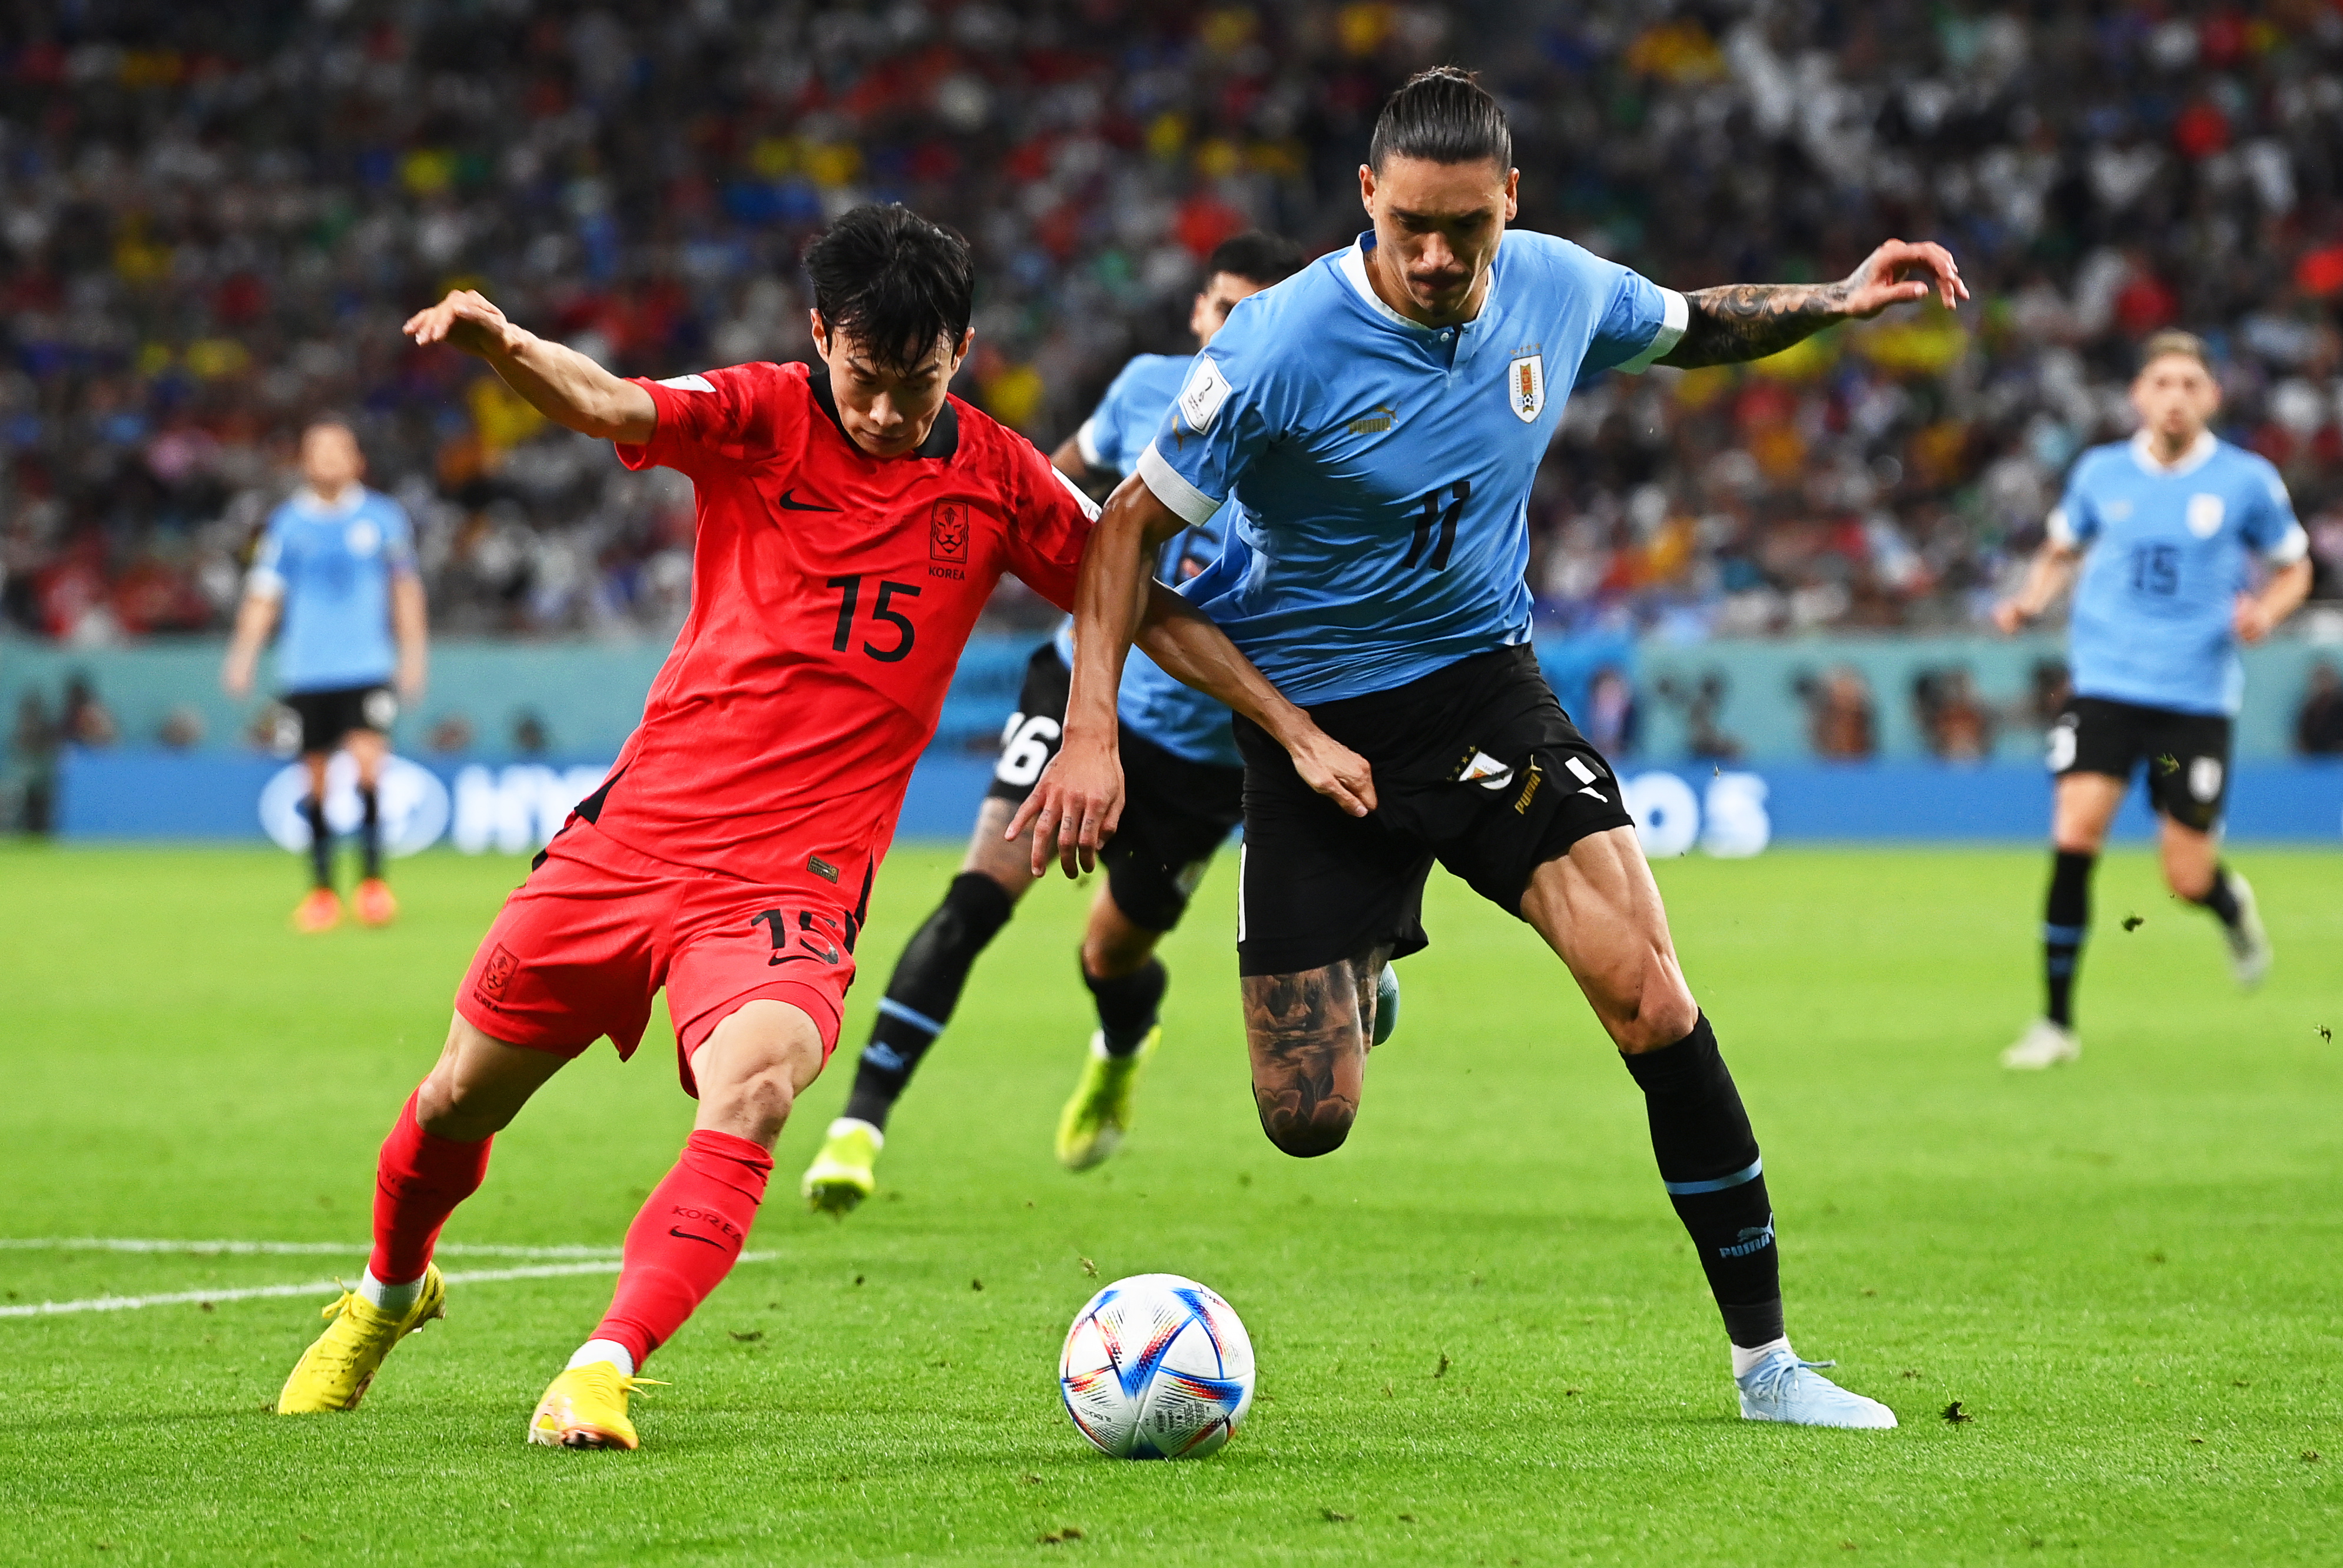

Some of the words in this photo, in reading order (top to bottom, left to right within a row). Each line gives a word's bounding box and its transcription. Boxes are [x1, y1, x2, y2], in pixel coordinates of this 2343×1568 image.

[1401, 481, 1470, 571] 11
[929, 565, 965, 581] KOREA
[2130, 543, 2179, 595] 15
[826, 575, 922, 662] 15
[1515, 772, 1542, 814] PUMA
[751, 909, 839, 964] 15
[672, 1205, 743, 1245] KOREA
[1719, 1233, 1770, 1259] PUMA
